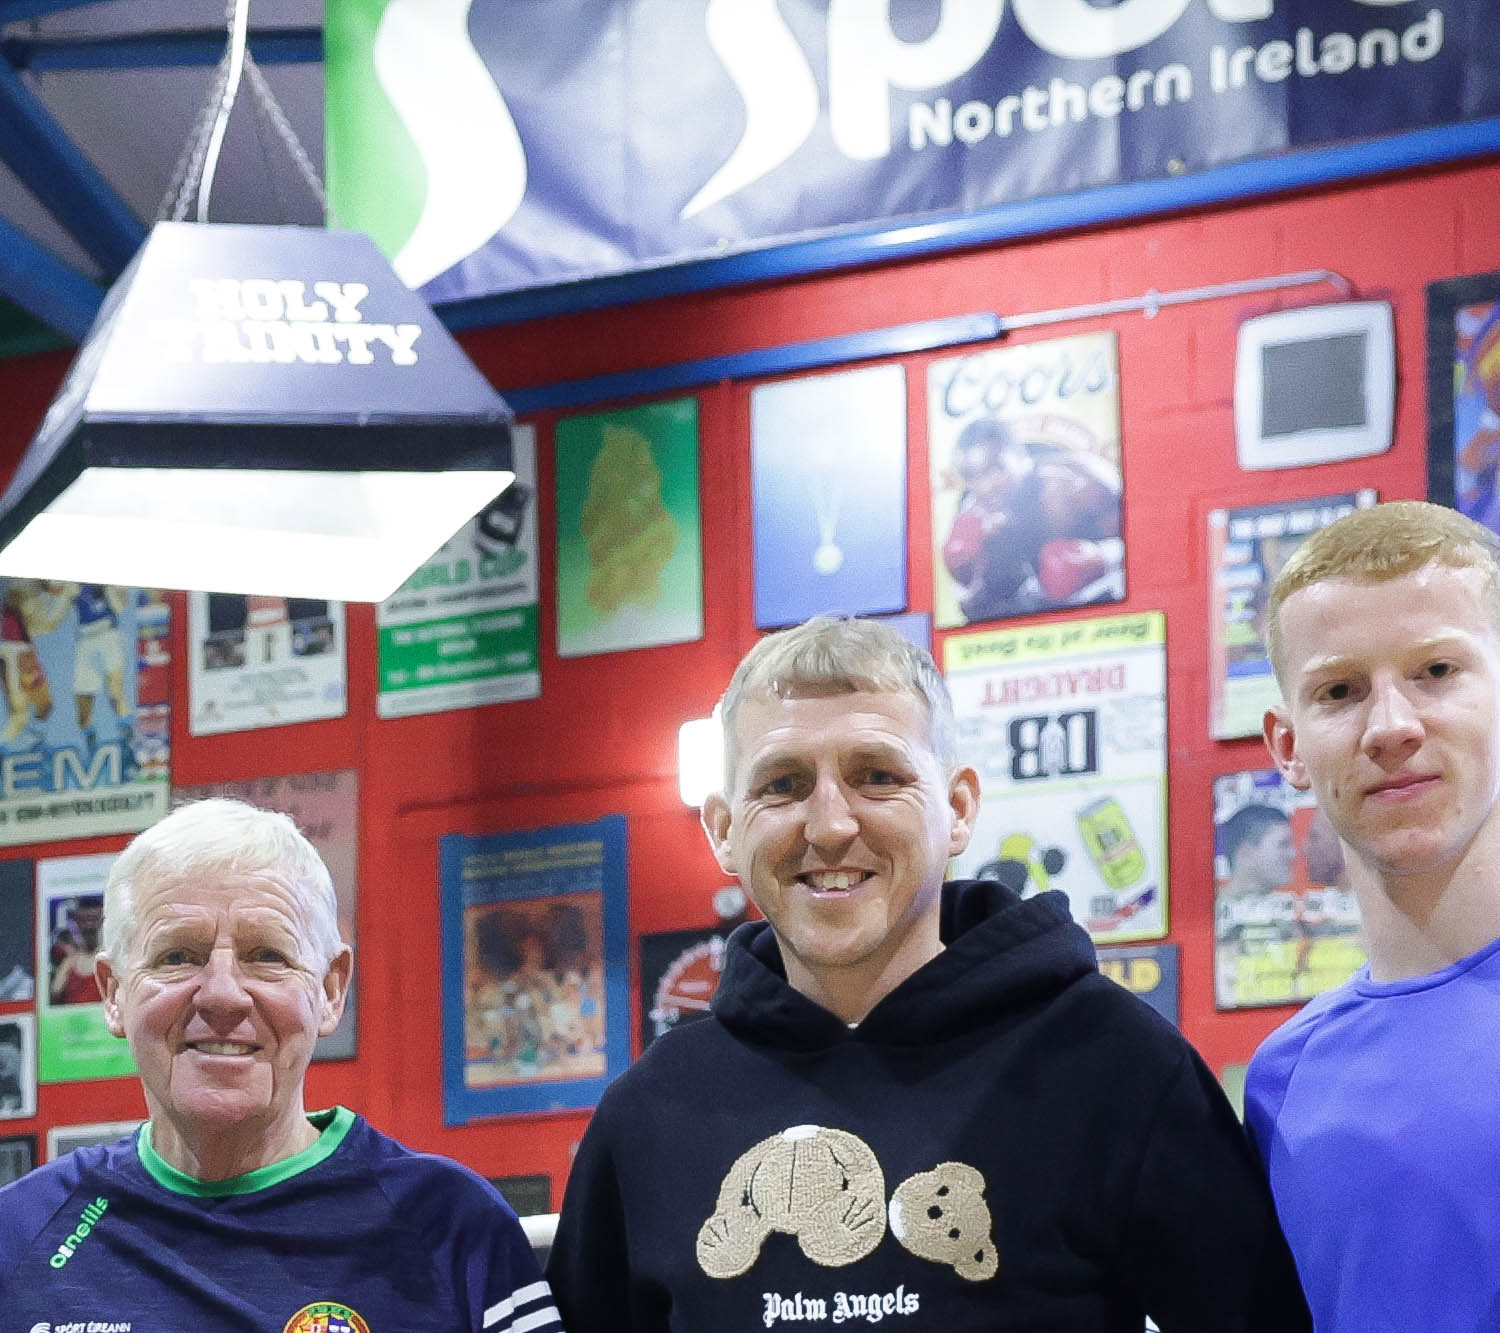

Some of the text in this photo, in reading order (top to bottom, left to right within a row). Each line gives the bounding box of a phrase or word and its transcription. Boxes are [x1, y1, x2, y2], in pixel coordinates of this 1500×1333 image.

[908, 9, 1445, 150] Northern Ireland
[190, 278, 370, 323] HOLY
[155, 321, 422, 365] TRINITY
[943, 348, 1112, 418] Coors
[3, 742, 122, 794] EM
[762, 1284, 921, 1329] Palm Angels
